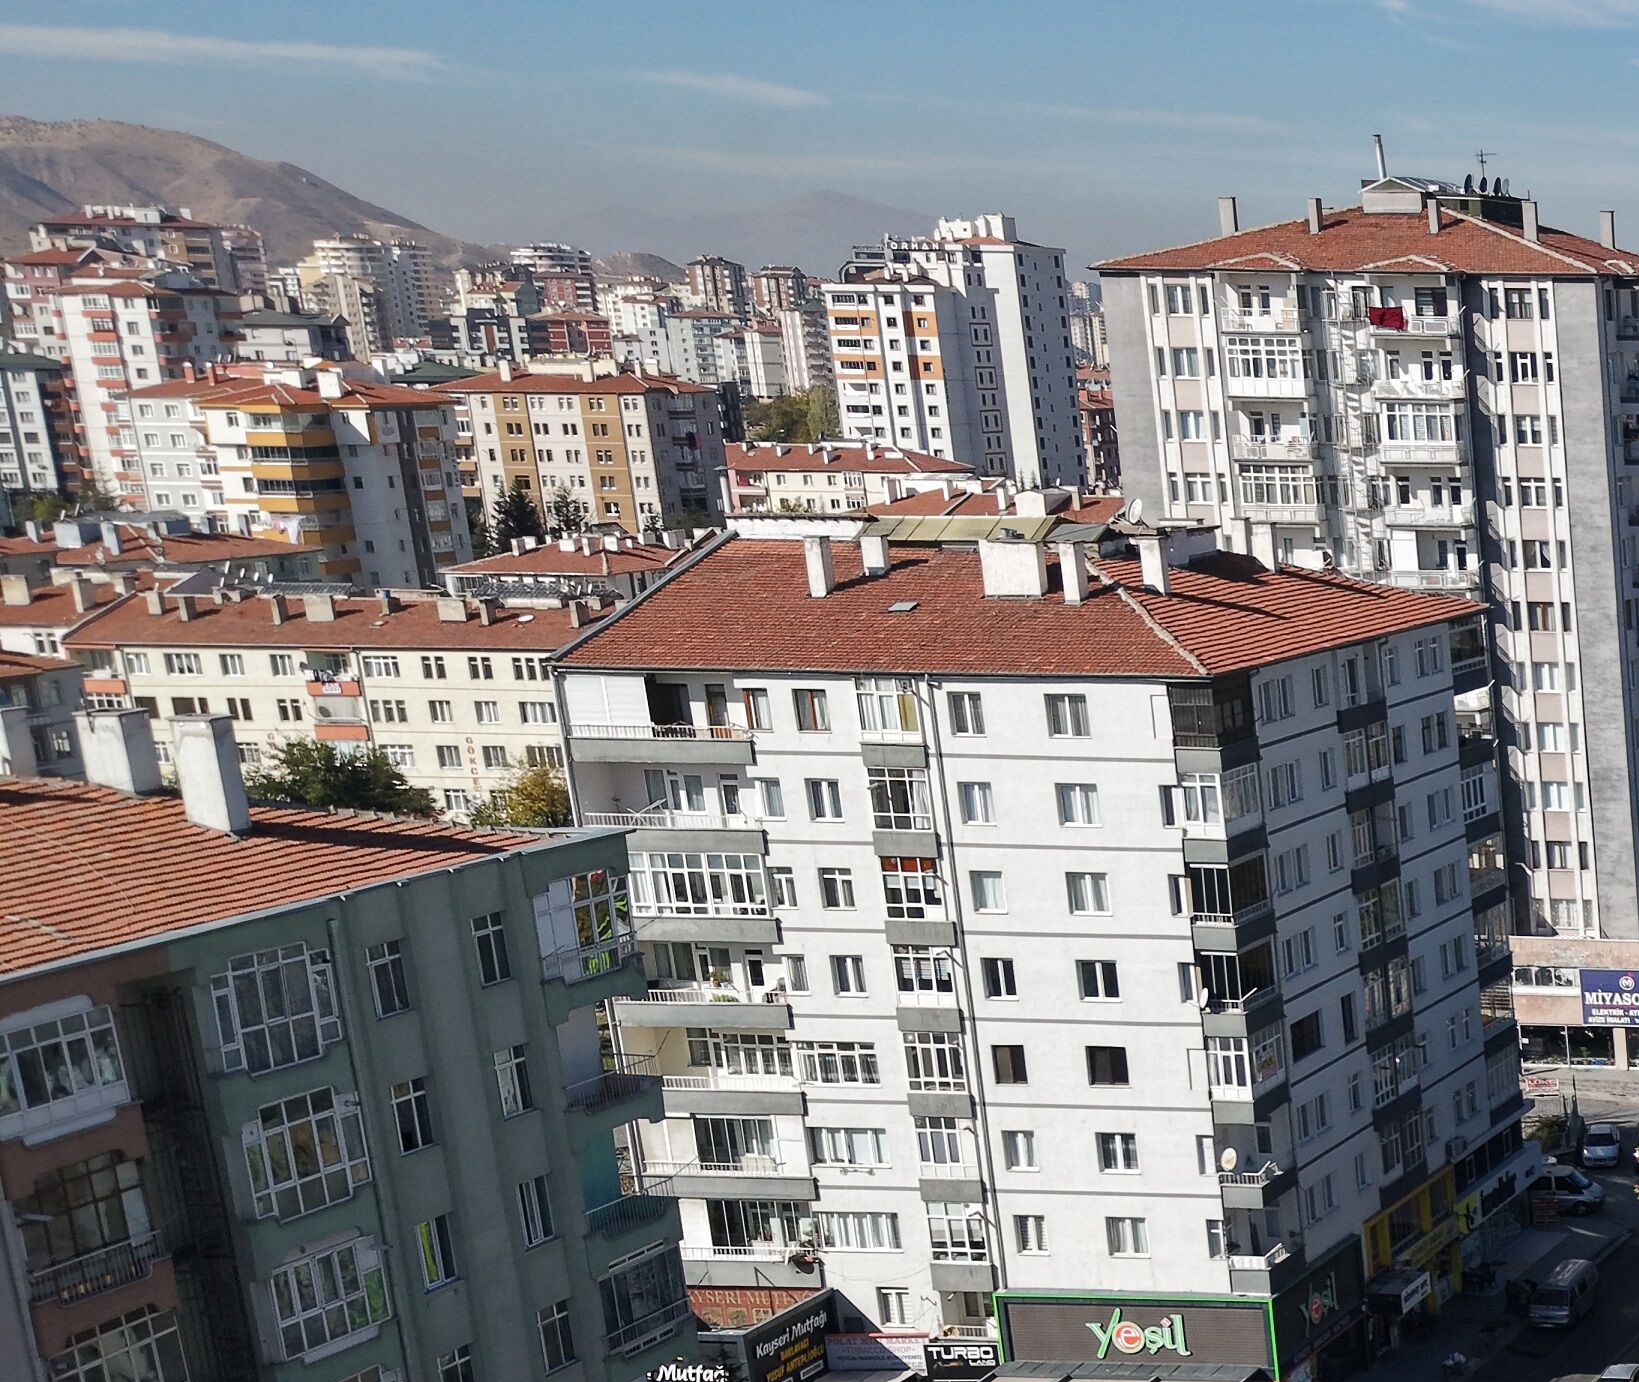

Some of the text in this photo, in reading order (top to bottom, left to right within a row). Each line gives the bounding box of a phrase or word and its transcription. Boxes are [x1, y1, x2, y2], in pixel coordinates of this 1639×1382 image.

[890, 242, 941, 251] ORHAN
[755, 1329, 791, 1360] Kayseri
[1084, 1307, 1194, 1360] Yeşil
[926, 1345, 995, 1361] TURBO
